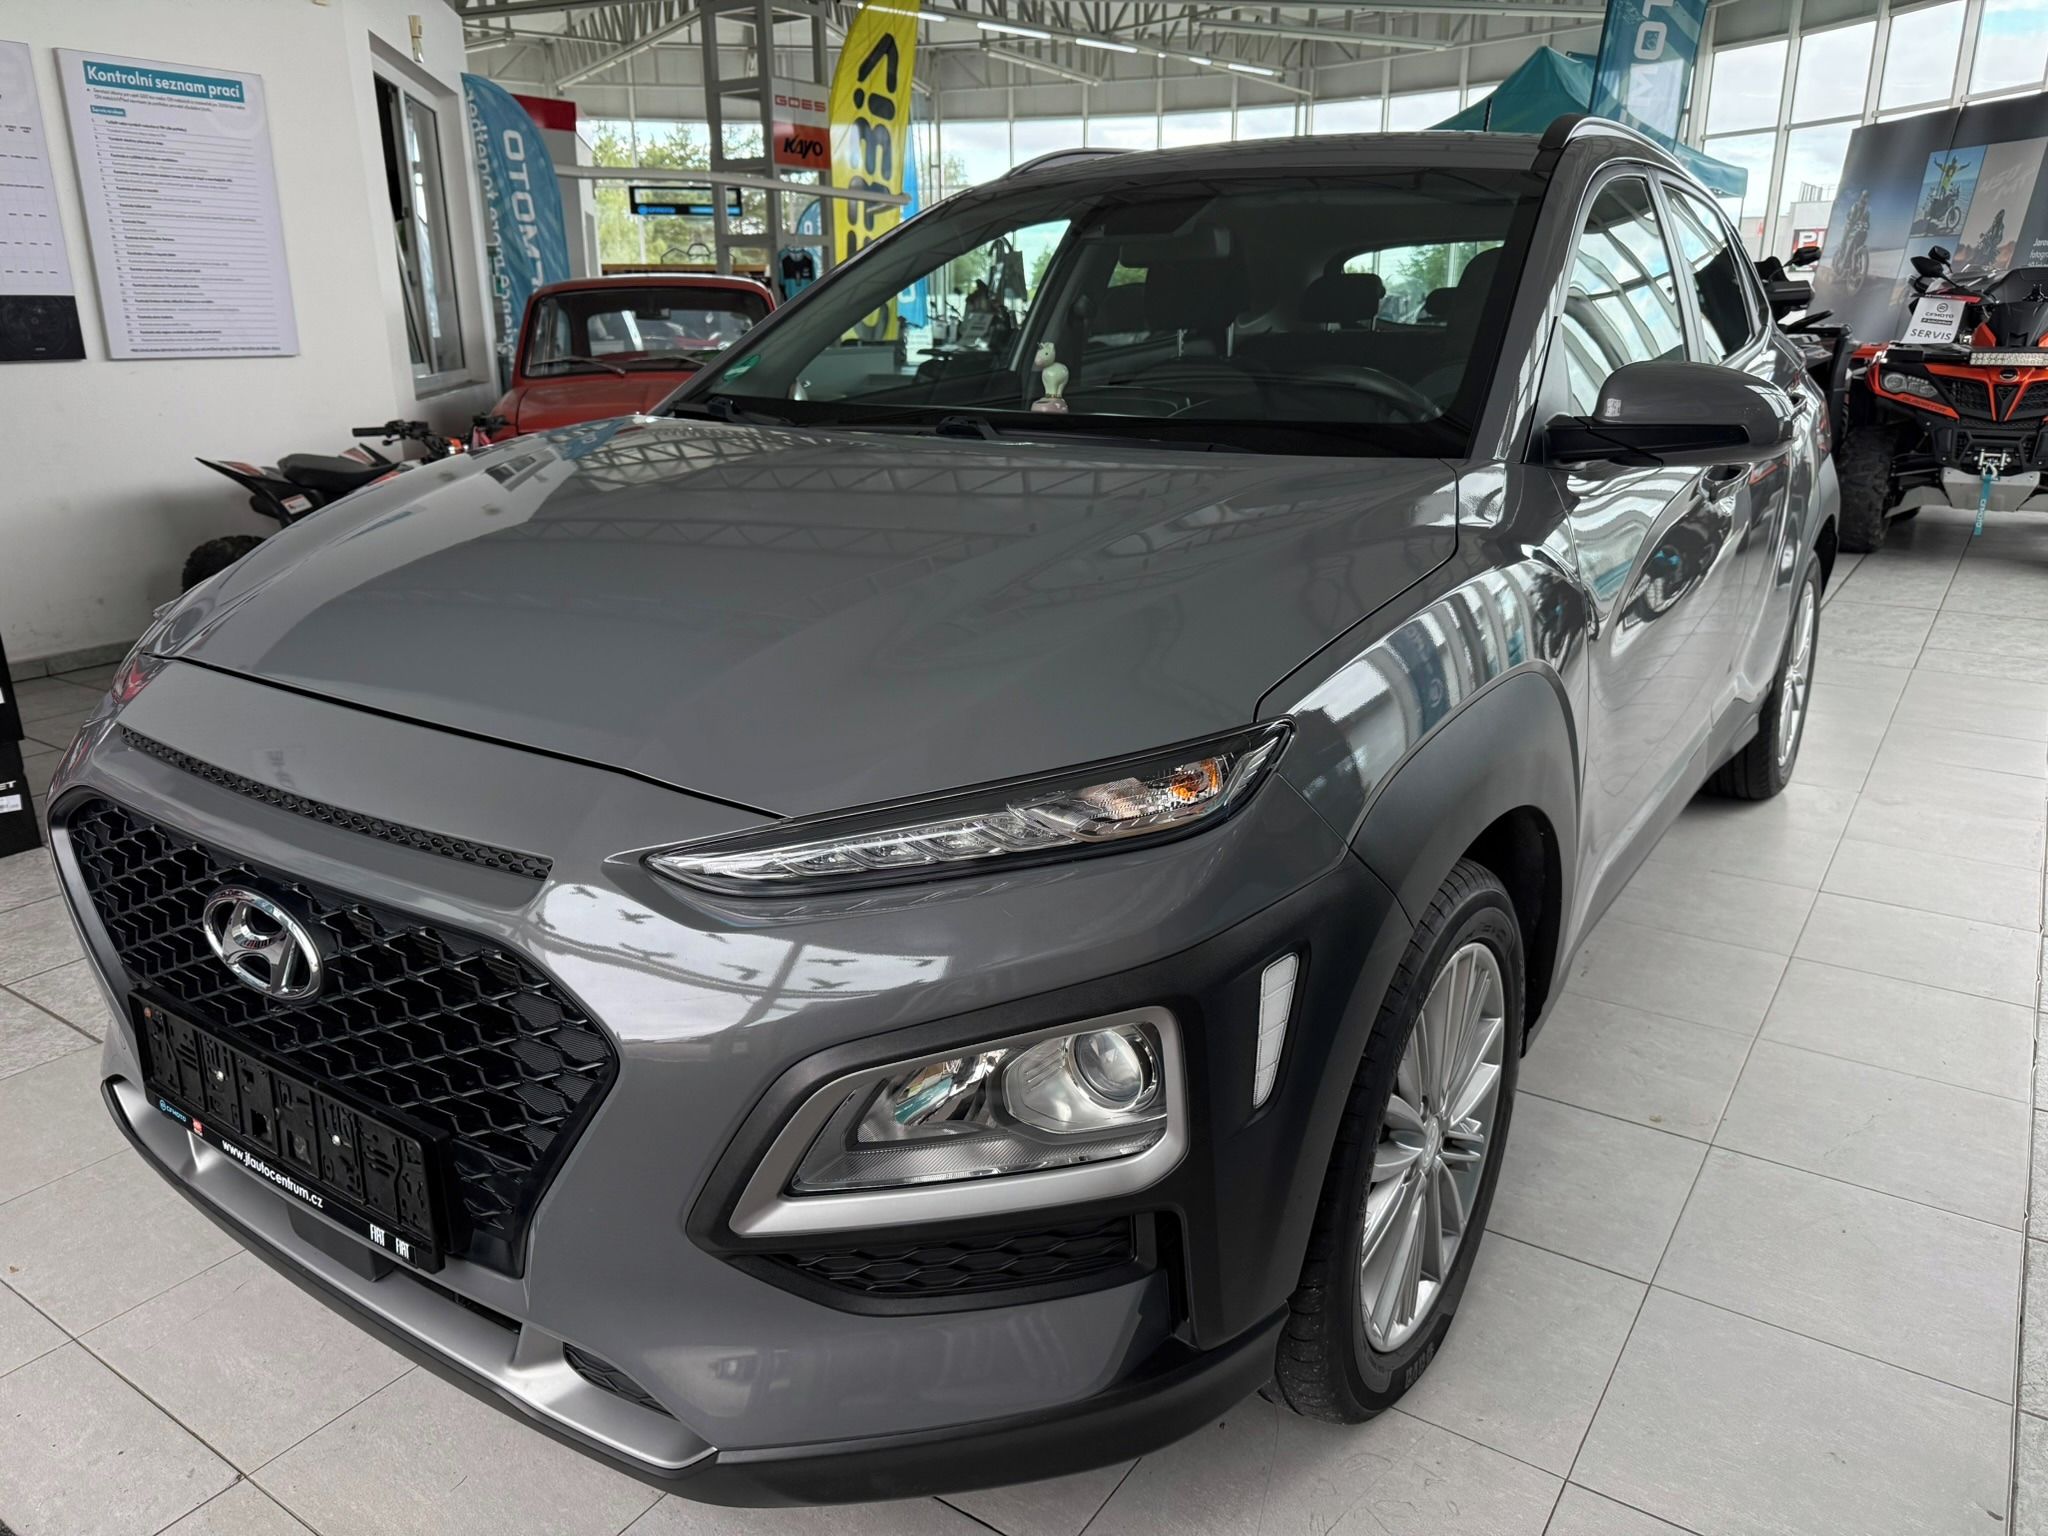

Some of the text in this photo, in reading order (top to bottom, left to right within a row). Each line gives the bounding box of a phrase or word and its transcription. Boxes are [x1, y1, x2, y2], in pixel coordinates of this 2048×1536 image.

[155, 78, 206, 94] seznam
[775, 94, 826, 112] GOES
[1910, 329, 1952, 341] SERVIS
[222, 1140, 323, 1208] www.jlautocentrum.cz
[370, 1223, 385, 1247] FIAT
[395, 1237, 409, 1259] FIAT
